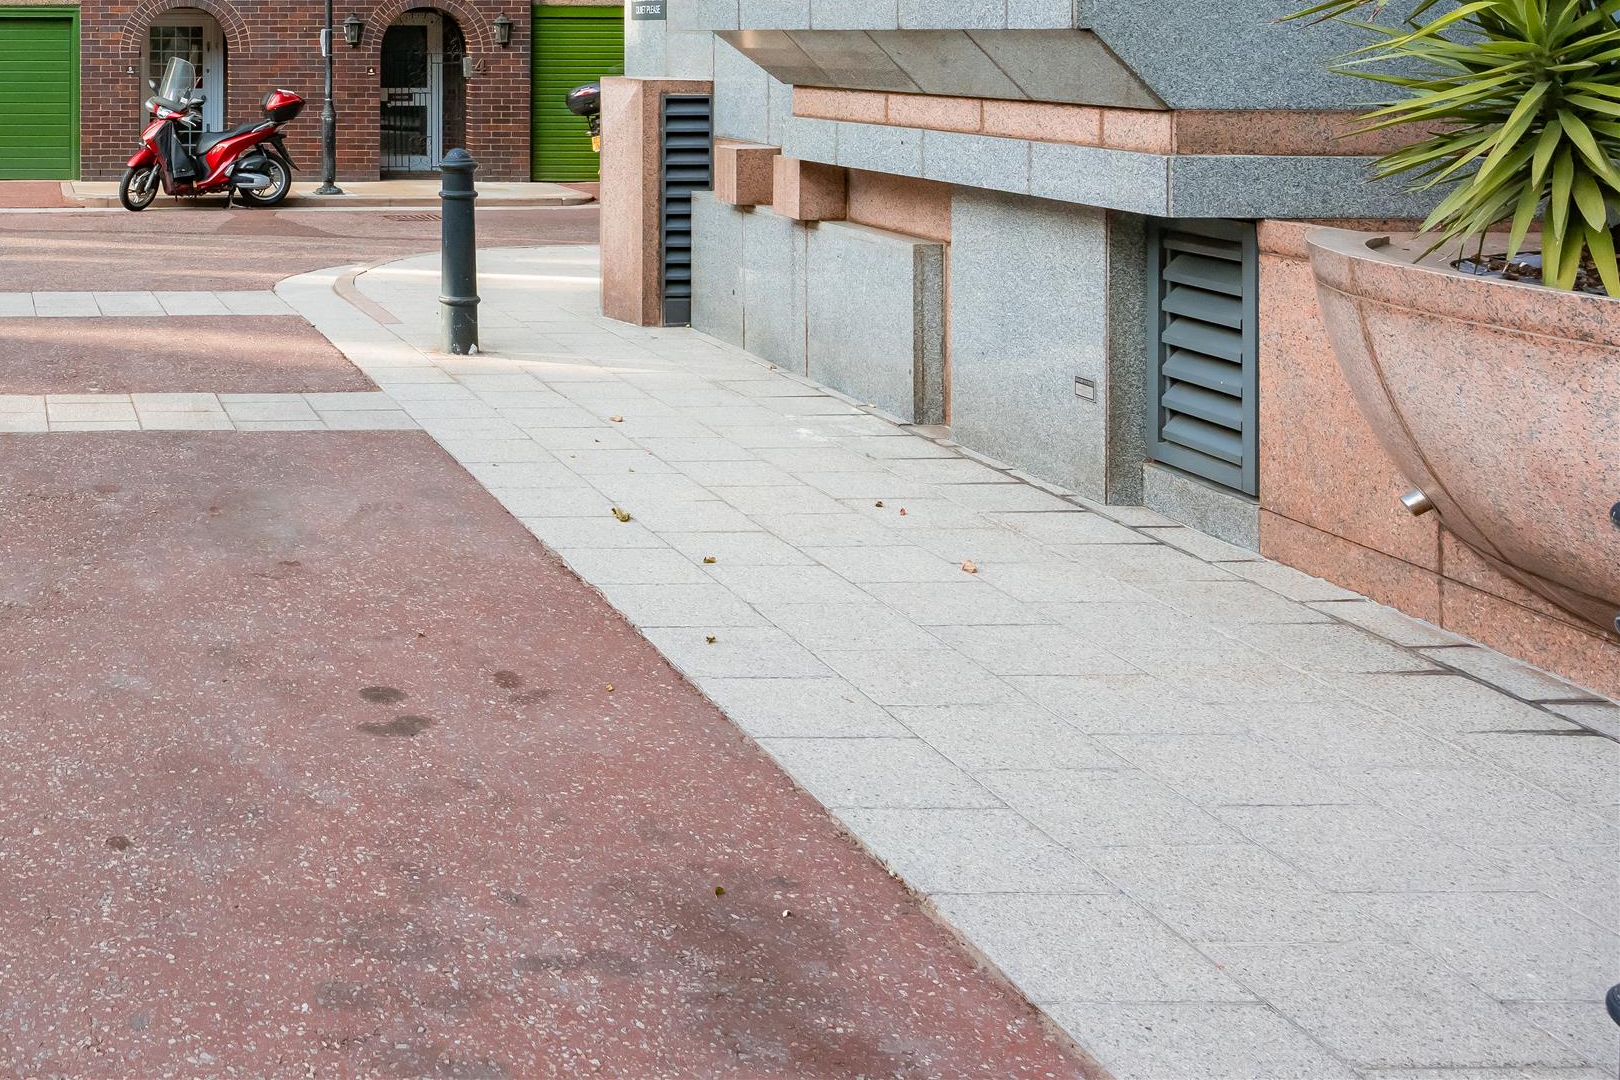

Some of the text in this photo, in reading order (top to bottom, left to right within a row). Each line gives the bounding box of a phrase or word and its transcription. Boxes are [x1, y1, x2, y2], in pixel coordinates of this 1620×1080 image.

[635, 4, 661, 15] QUIET PLEASE
[474, 57, 486, 73] 4
